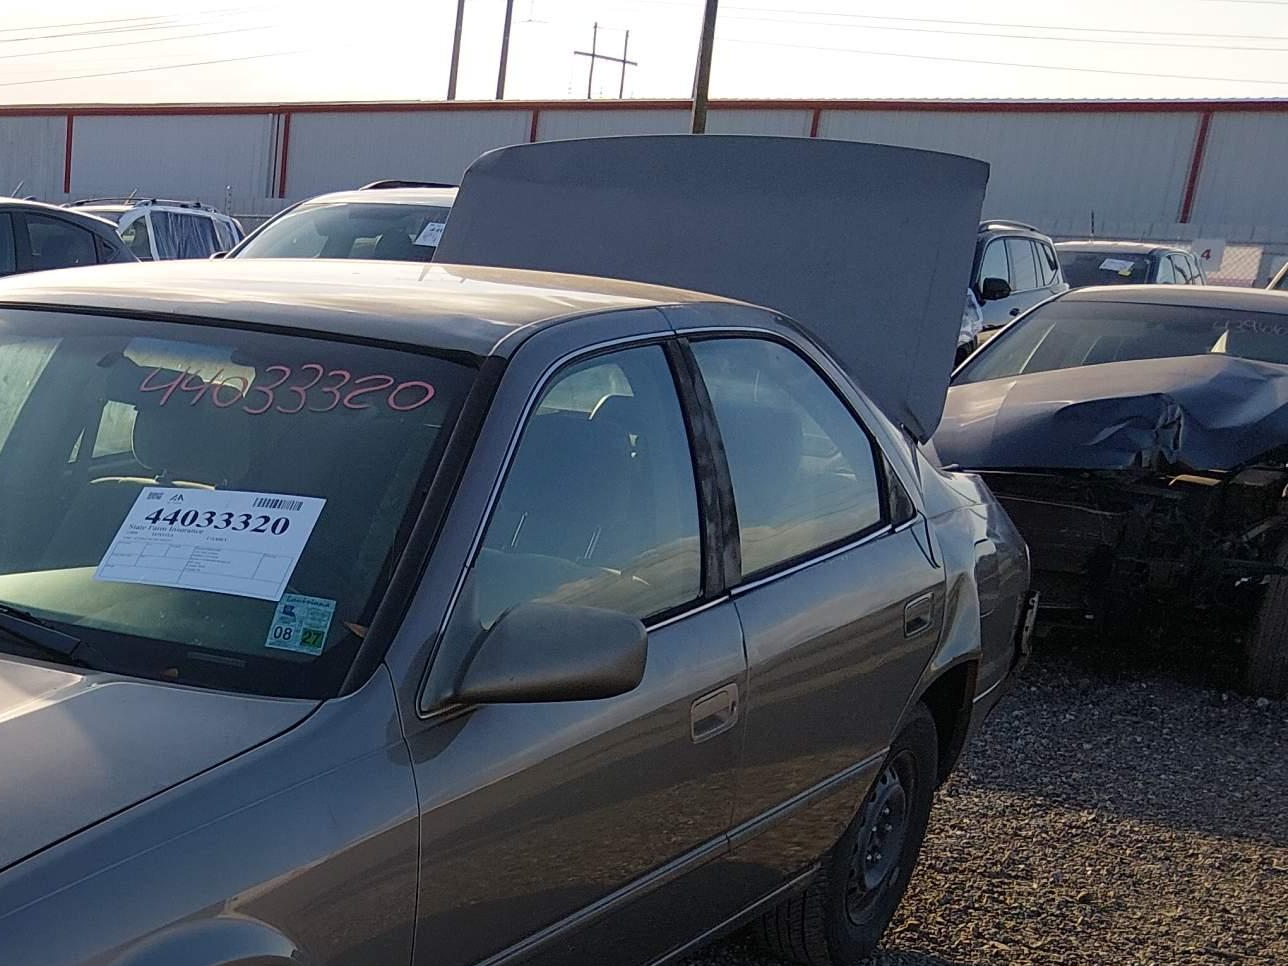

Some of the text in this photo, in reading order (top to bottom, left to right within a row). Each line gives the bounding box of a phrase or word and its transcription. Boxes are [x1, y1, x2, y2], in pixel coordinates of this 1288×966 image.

[1201, 249, 1211, 260] 4
[140, 363, 435, 414] 44033320
[144, 507, 290, 536] 44033320
[148, 525, 168, 533] Farm
[168, 526, 205, 535] Insurance
[273, 626, 322, 645] 08 27
